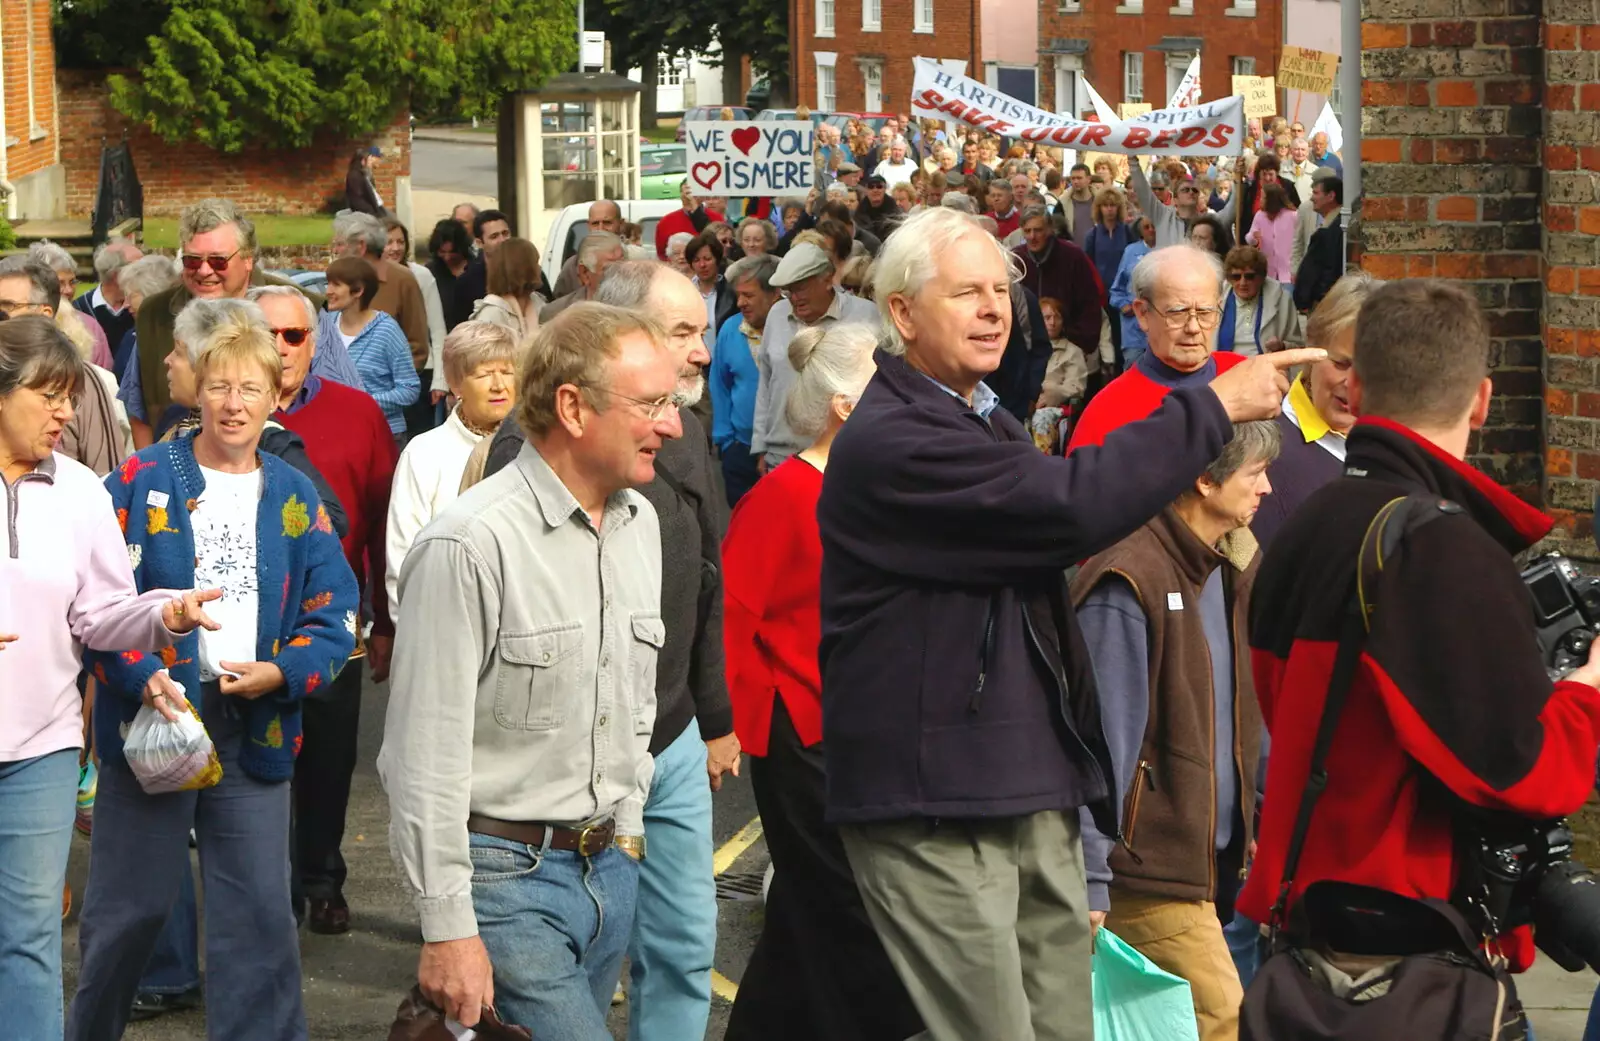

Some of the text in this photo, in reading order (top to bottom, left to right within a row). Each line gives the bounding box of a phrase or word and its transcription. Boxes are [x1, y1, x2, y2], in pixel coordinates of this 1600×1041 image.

[911, 89, 1236, 149] SAVE OUR BEDS
[934, 71, 1090, 126] HARTISMER
[688, 128, 814, 158] WE YOU
